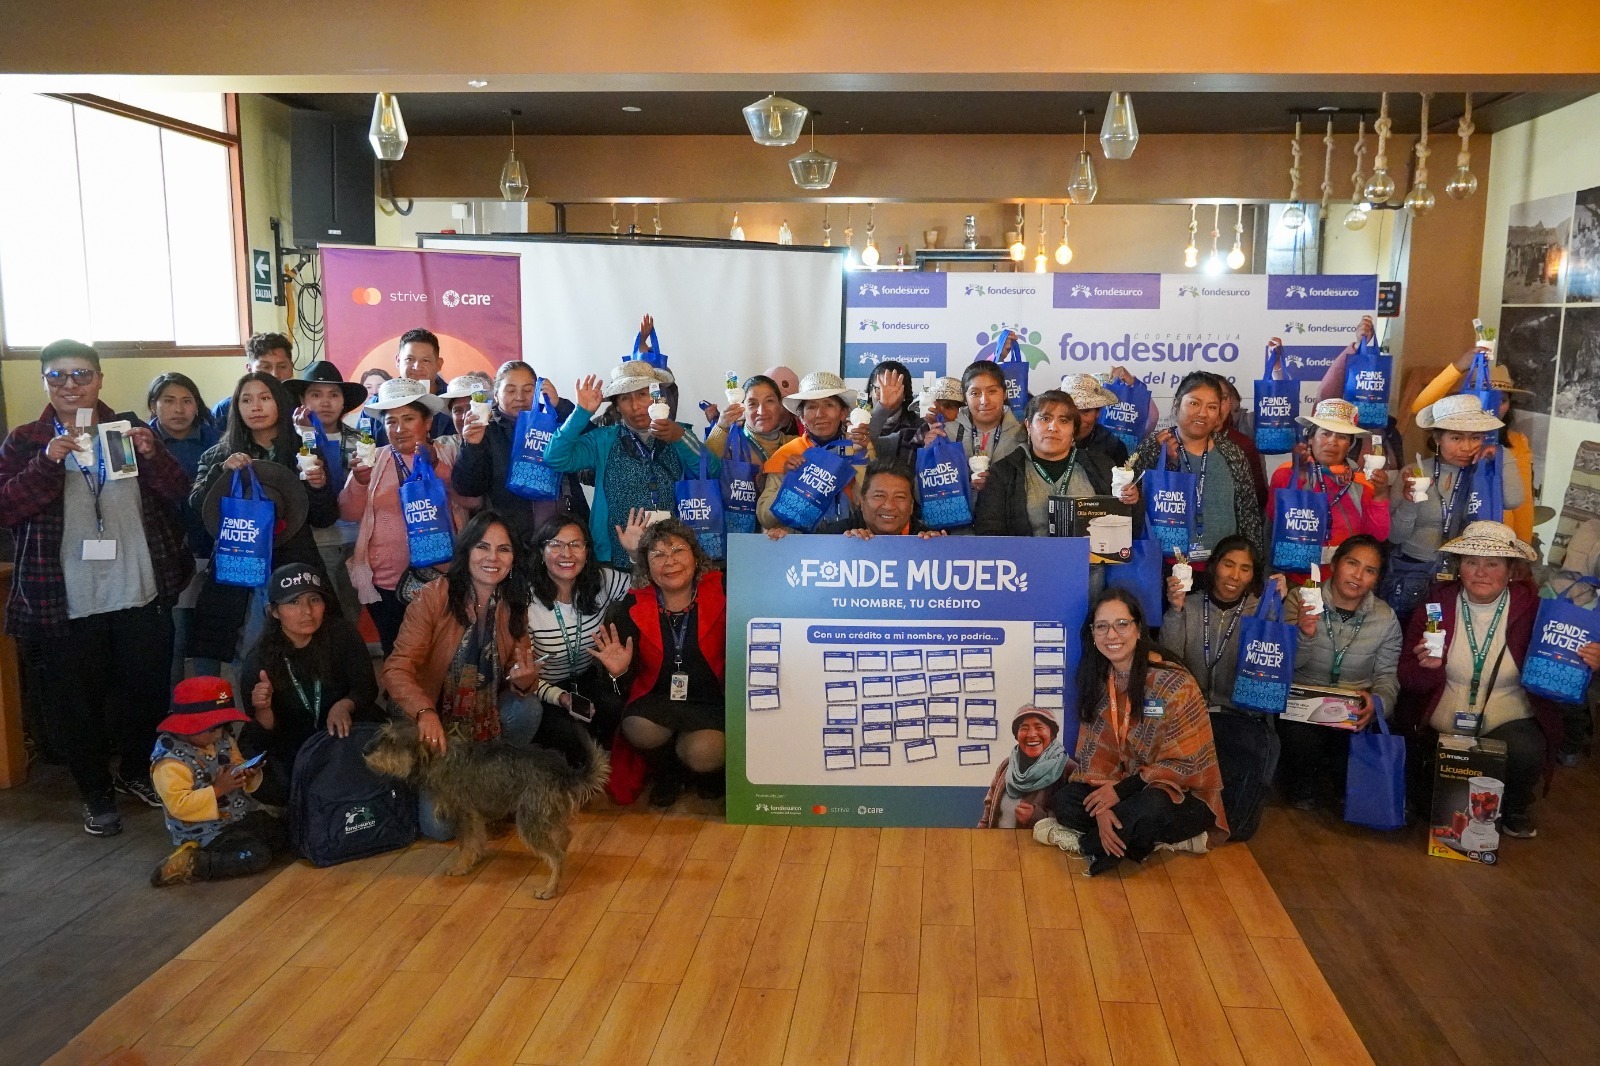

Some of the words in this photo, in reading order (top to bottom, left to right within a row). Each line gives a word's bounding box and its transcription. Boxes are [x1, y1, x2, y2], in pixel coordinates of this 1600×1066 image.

[255, 288, 272, 299] SALIDA
[881, 285, 930, 295] fondesurco
[987, 286, 1036, 295] fondesurco
[1093, 287, 1143, 296] fondesurco
[1201, 287, 1251, 297] fondesurco
[1309, 288, 1359, 297] fondesurco
[390, 291, 428, 302] strive
[461, 293, 491, 305] care
[881, 321, 930, 330] fondesurco
[1307, 323, 1357, 333] fondesurco
[1133, 332, 1241, 341] COOPERATIVA
[1058, 332, 1240, 363] fondesurco
[1142, 371, 1166, 384] del
[1360, 370, 1383, 380] FONDE
[1356, 380, 1384, 391] MUJER
[1262, 396, 1288, 406] FONDE
[1105, 408, 1136, 423] MUJER
[1260, 406, 1291, 417] MUJER
[529, 428, 553, 441] FOND
[524, 439, 547, 452] MUJ
[807, 463, 837, 486] FONDE
[922, 472, 959, 488] MUJER
[799, 473, 833, 497] MUJER
[1158, 490, 1184, 502] FONDE
[680, 498, 707, 509] FONDE
[1154, 502, 1186, 515] MUJER
[679, 509, 710, 521] MUJER
[223, 517, 255, 530] FONDE
[1286, 519, 1319, 532] MUJER
[220, 528, 256, 543] MUJER
[800, 559, 899, 588] FONDE
[906, 559, 1017, 592] MUJER
[832, 598, 847, 608] TU
[850, 598, 906, 610] NOMBRE,
[910, 599, 924, 609] TU
[928, 596, 981, 609] CRÉDITO
[813, 630, 832, 639] Con
[849, 630, 882, 640] crédito
[893, 631, 905, 640] mi
[907, 631, 944, 641] nombre,
[946, 633, 958, 642] yo
[1547, 620, 1590, 641] FONDE
[1252, 639, 1281, 654] FONDE
[1245, 651, 1281, 668] MUJER
[1440, 764, 1483, 777] Licuadora
